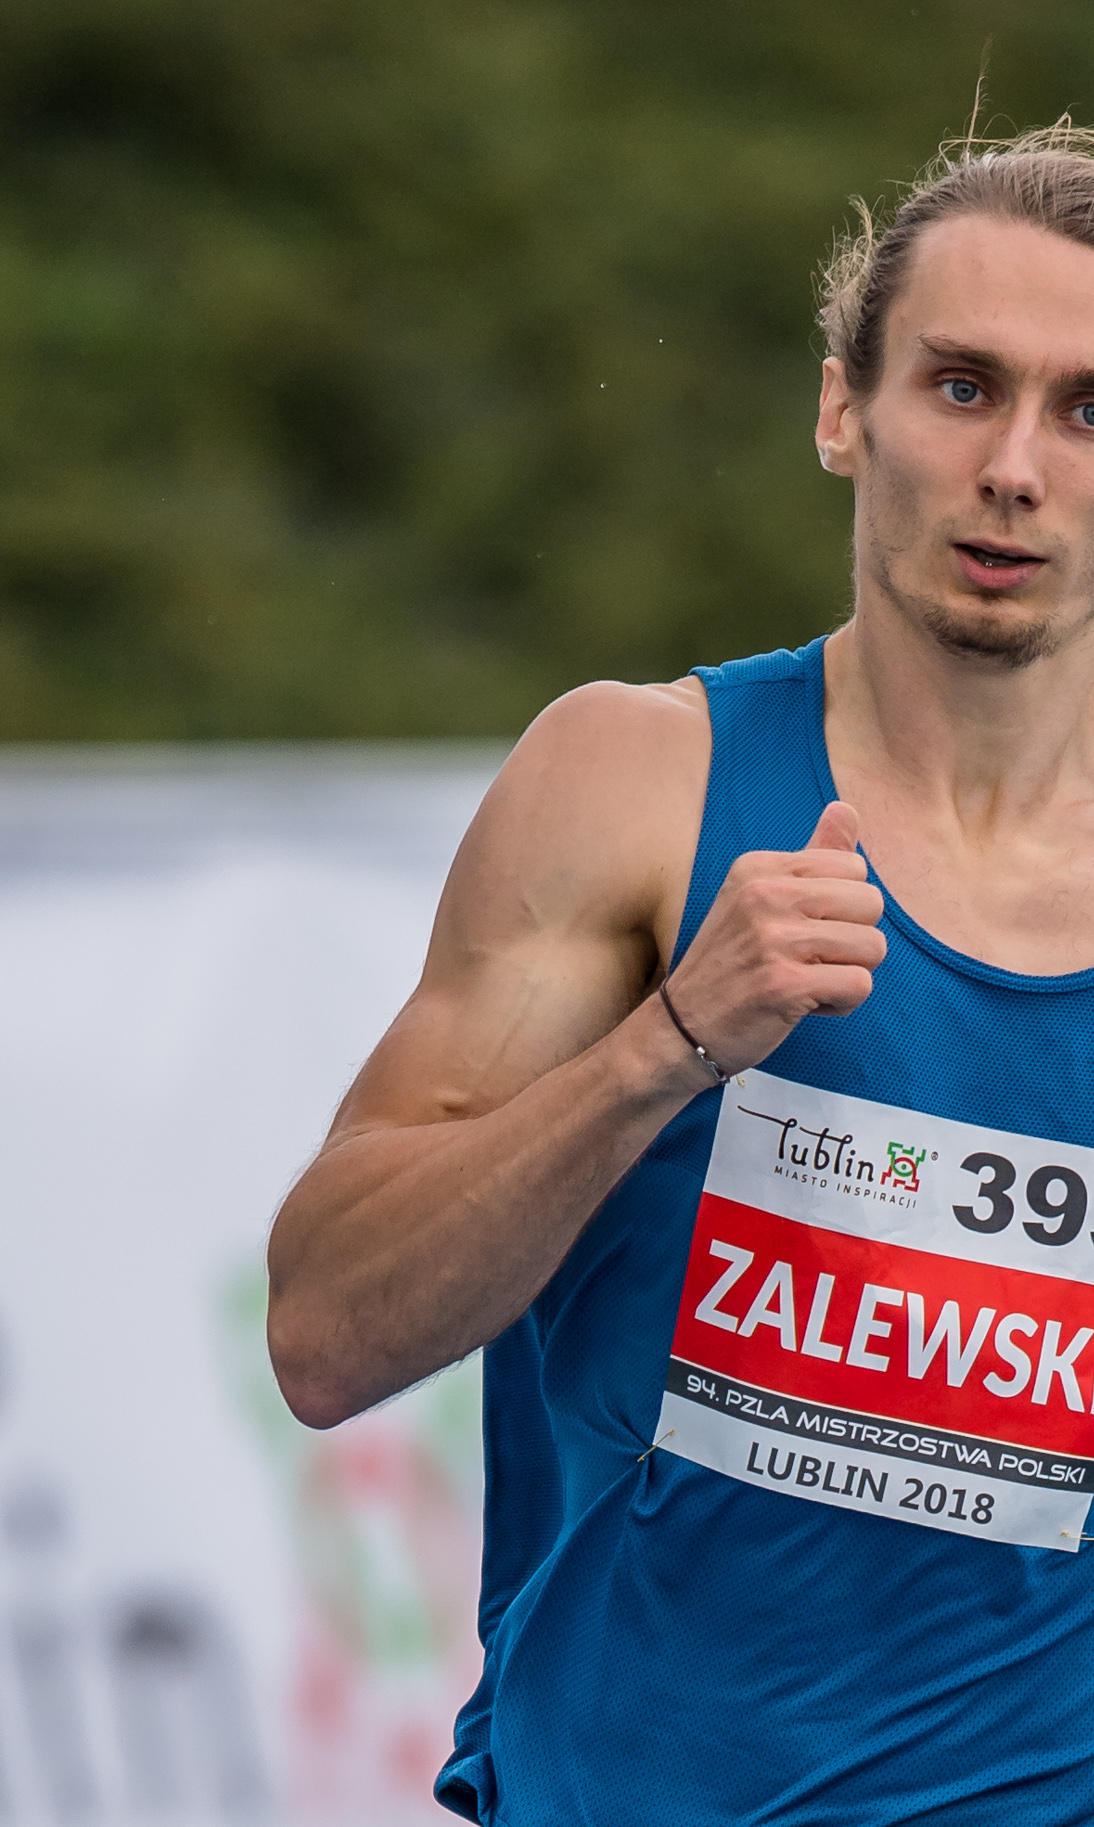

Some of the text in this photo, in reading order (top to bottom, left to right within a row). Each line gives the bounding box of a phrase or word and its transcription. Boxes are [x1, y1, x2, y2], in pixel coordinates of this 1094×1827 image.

[774, 1165, 918, 1209] MIASTO INSPIRACJI
[687, 1374, 1086, 1484] 94. PZLA MISTRZOSTWA POLSKI
[746, 1441, 995, 1525] LUBLIN 2018
